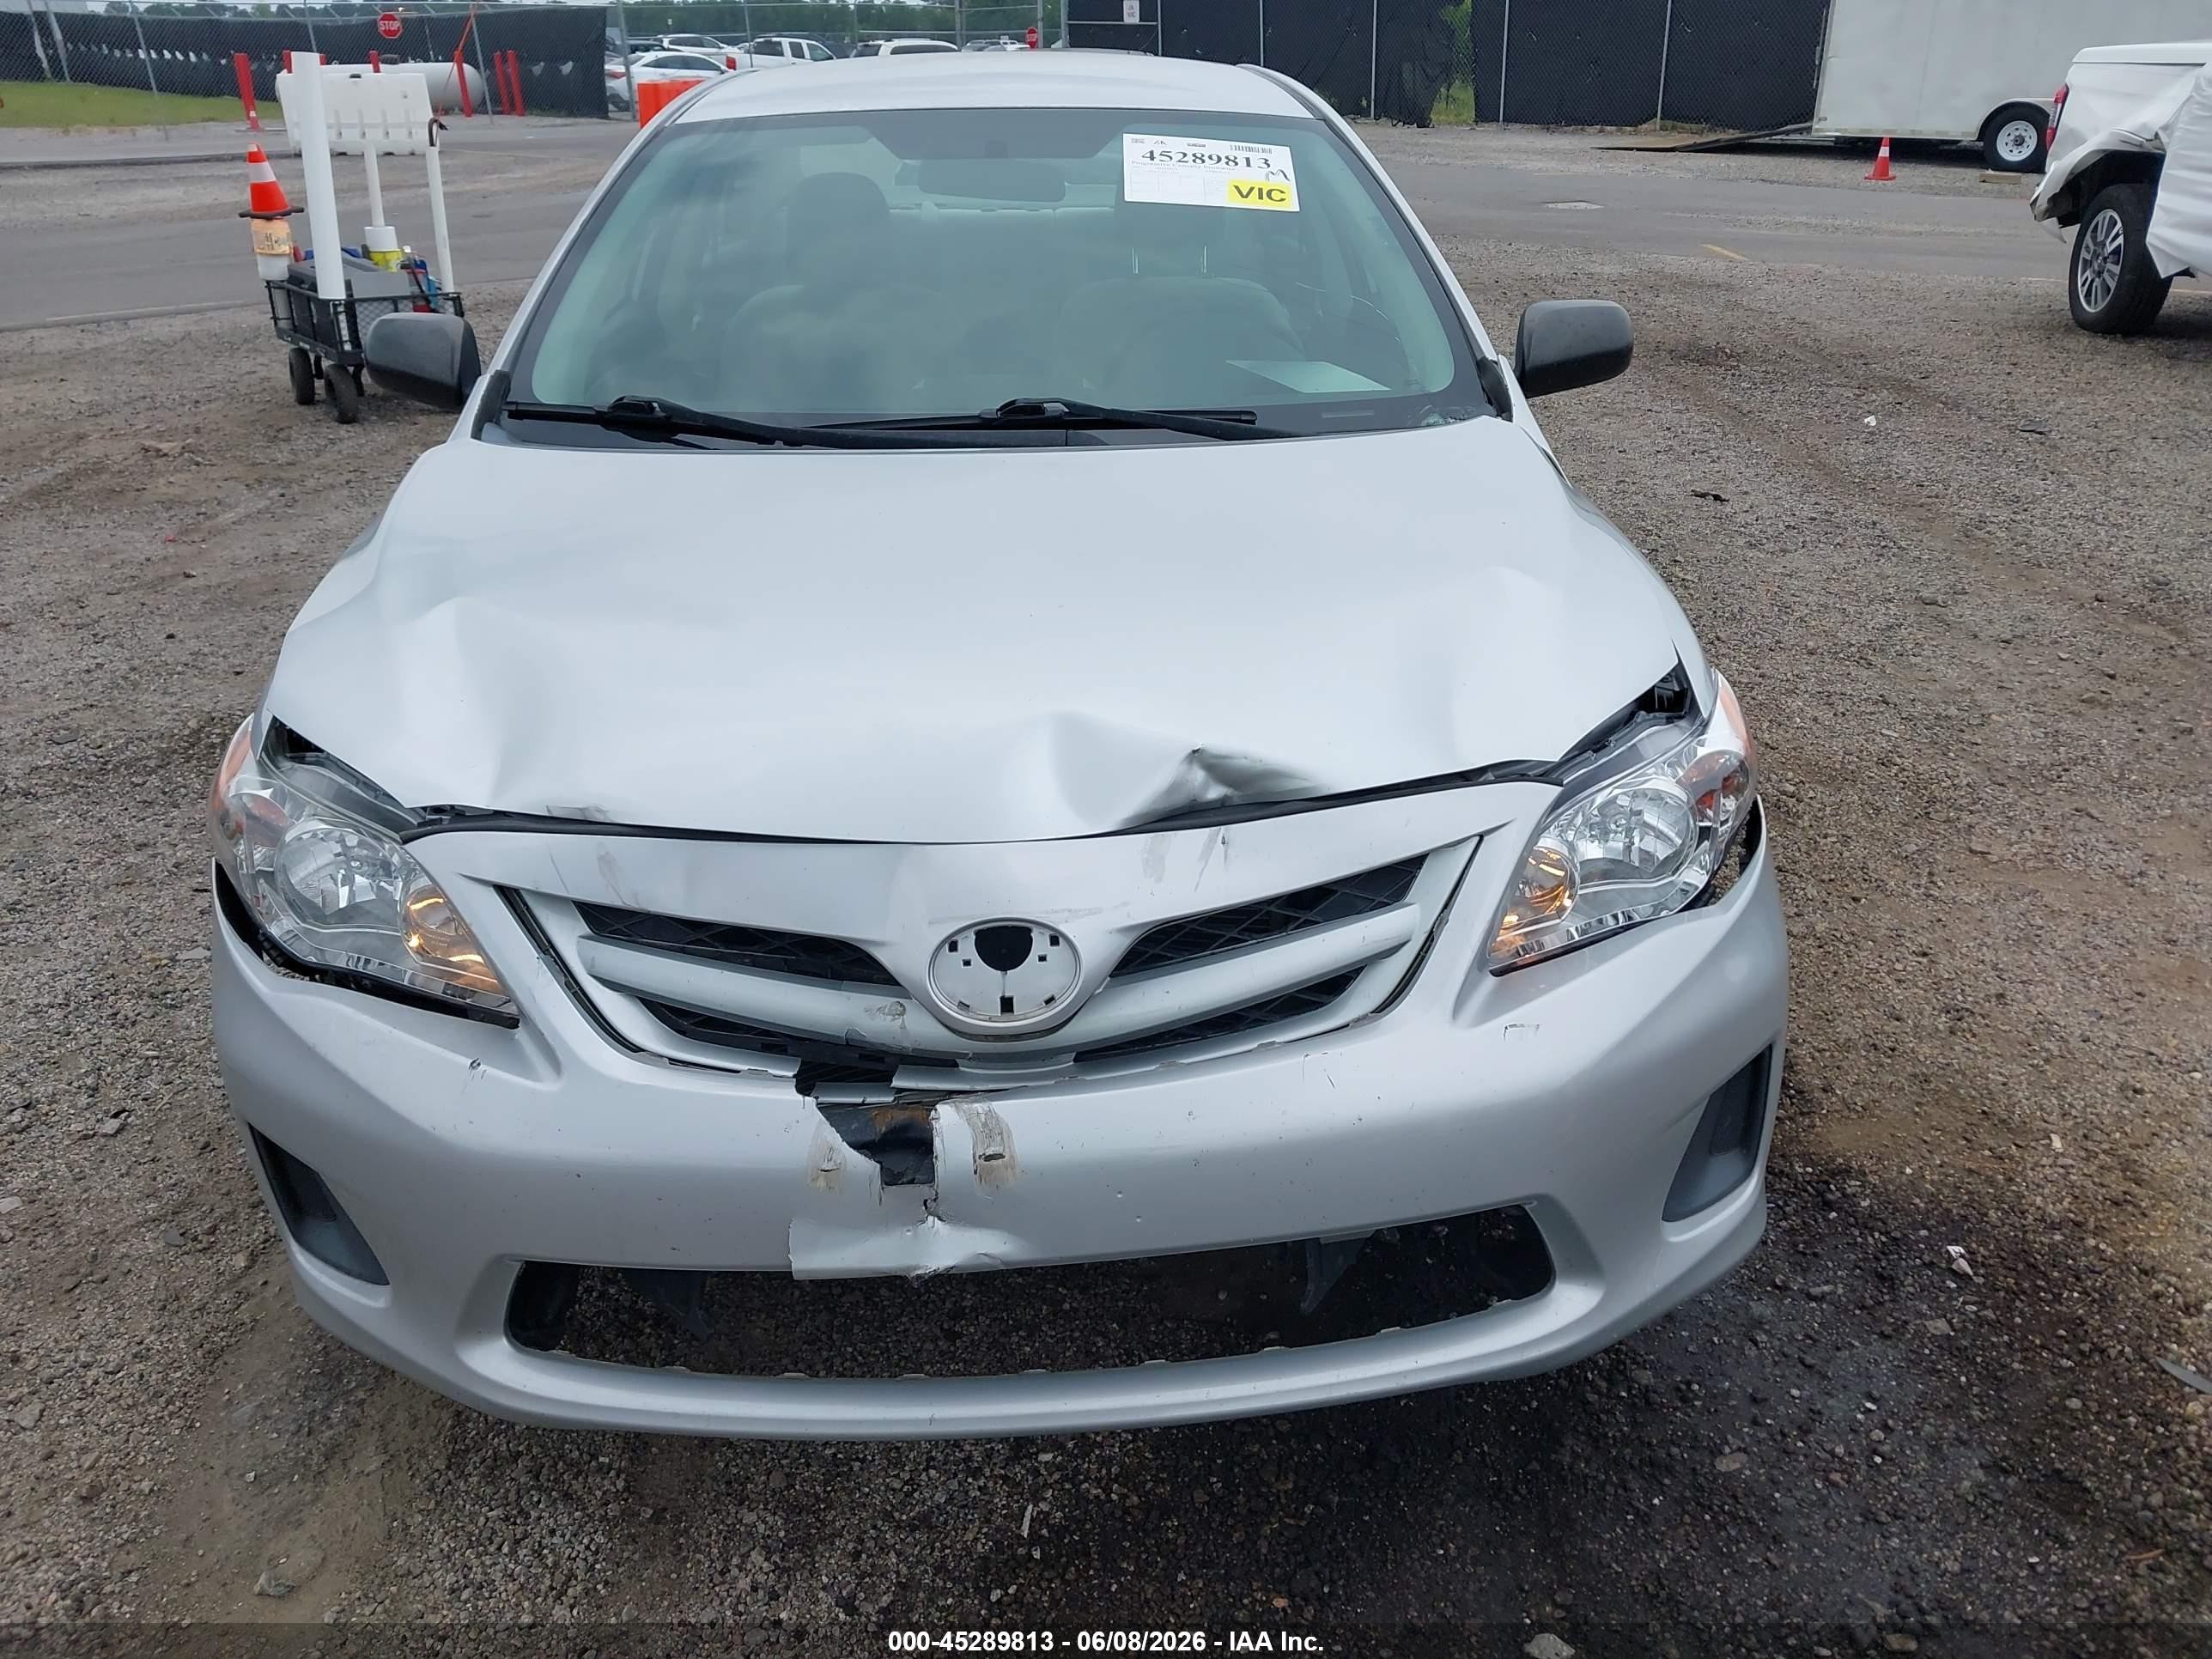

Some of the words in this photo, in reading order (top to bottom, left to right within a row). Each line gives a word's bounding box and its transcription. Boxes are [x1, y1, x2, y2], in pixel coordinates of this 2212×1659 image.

[380, 20, 399, 30] STOP
[1140, 149, 1272, 169] 45289813
[1232, 185, 1287, 203] VIC
